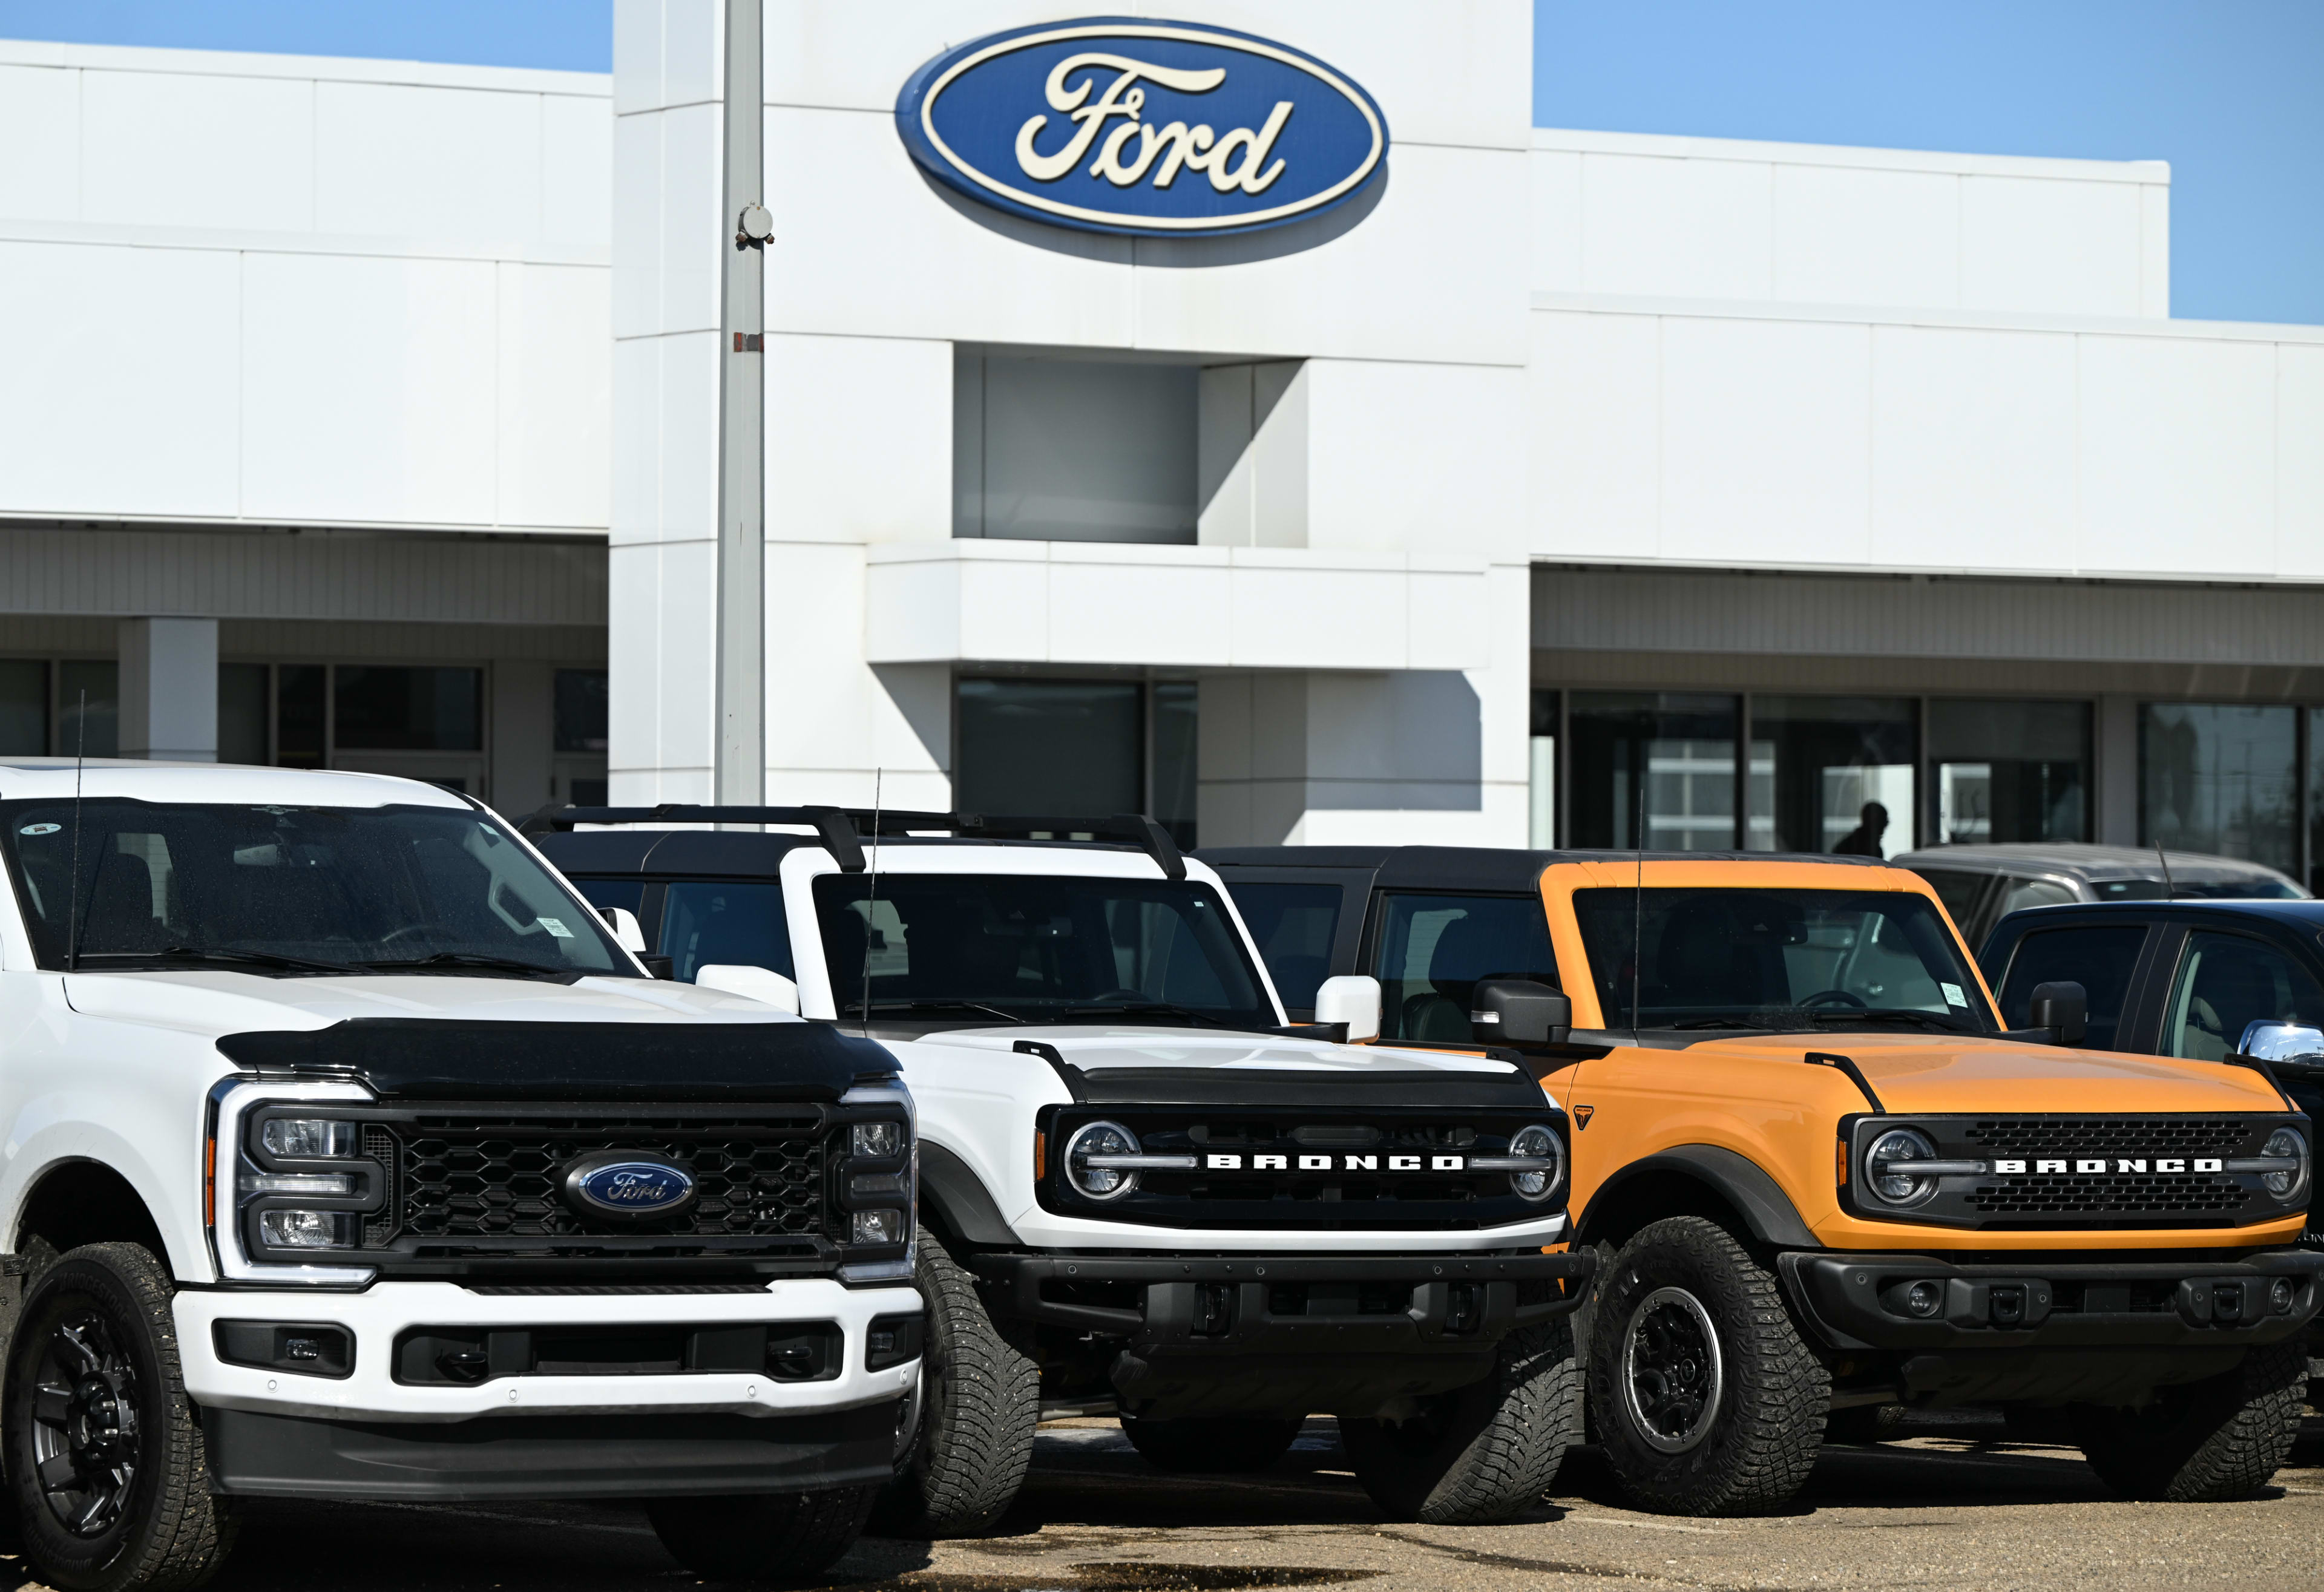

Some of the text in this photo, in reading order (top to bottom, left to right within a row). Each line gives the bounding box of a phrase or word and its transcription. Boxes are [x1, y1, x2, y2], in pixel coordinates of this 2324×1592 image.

[1015, 52, 1294, 194] Ford
[1207, 1154, 1463, 1170] BRONCO
[1995, 1159, 2222, 1173] BRONCO
[607, 1172, 668, 1200] Ford
[58, 1272, 130, 1323] BRIDGESTONE
